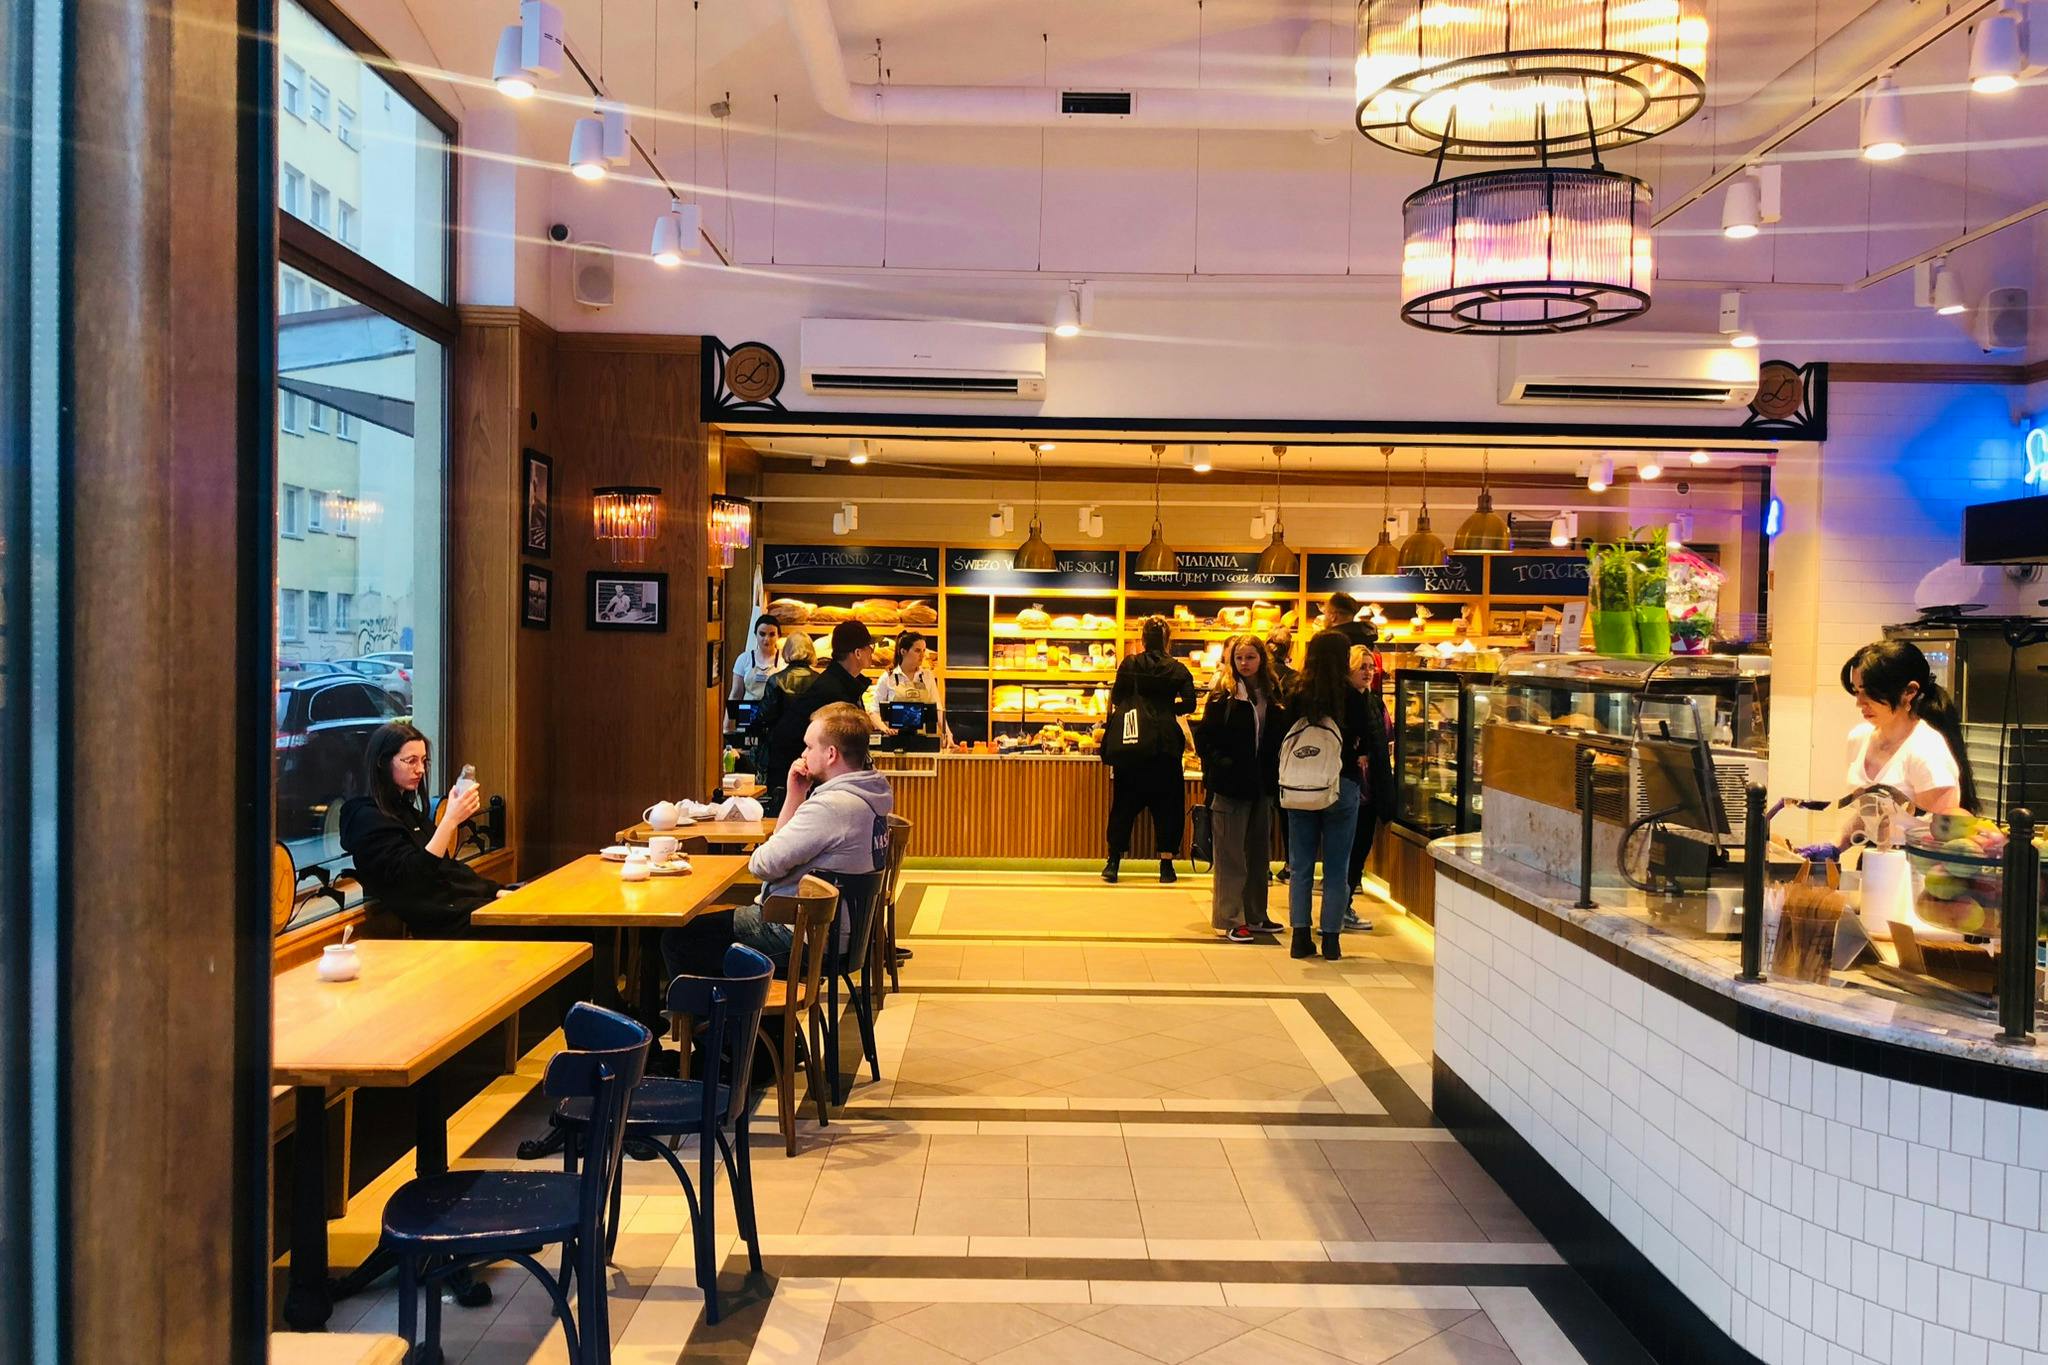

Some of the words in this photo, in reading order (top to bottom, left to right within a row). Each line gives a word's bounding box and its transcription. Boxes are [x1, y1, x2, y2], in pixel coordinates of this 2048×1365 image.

[774, 552, 818, 570] PIZZA
[822, 552, 870, 566] PROSTO
[872, 554, 883, 566] Z
[1176, 555, 1239, 568] NIADANIA
[1212, 573, 1225, 583] DO
[1424, 578, 1471, 592] KAWA
